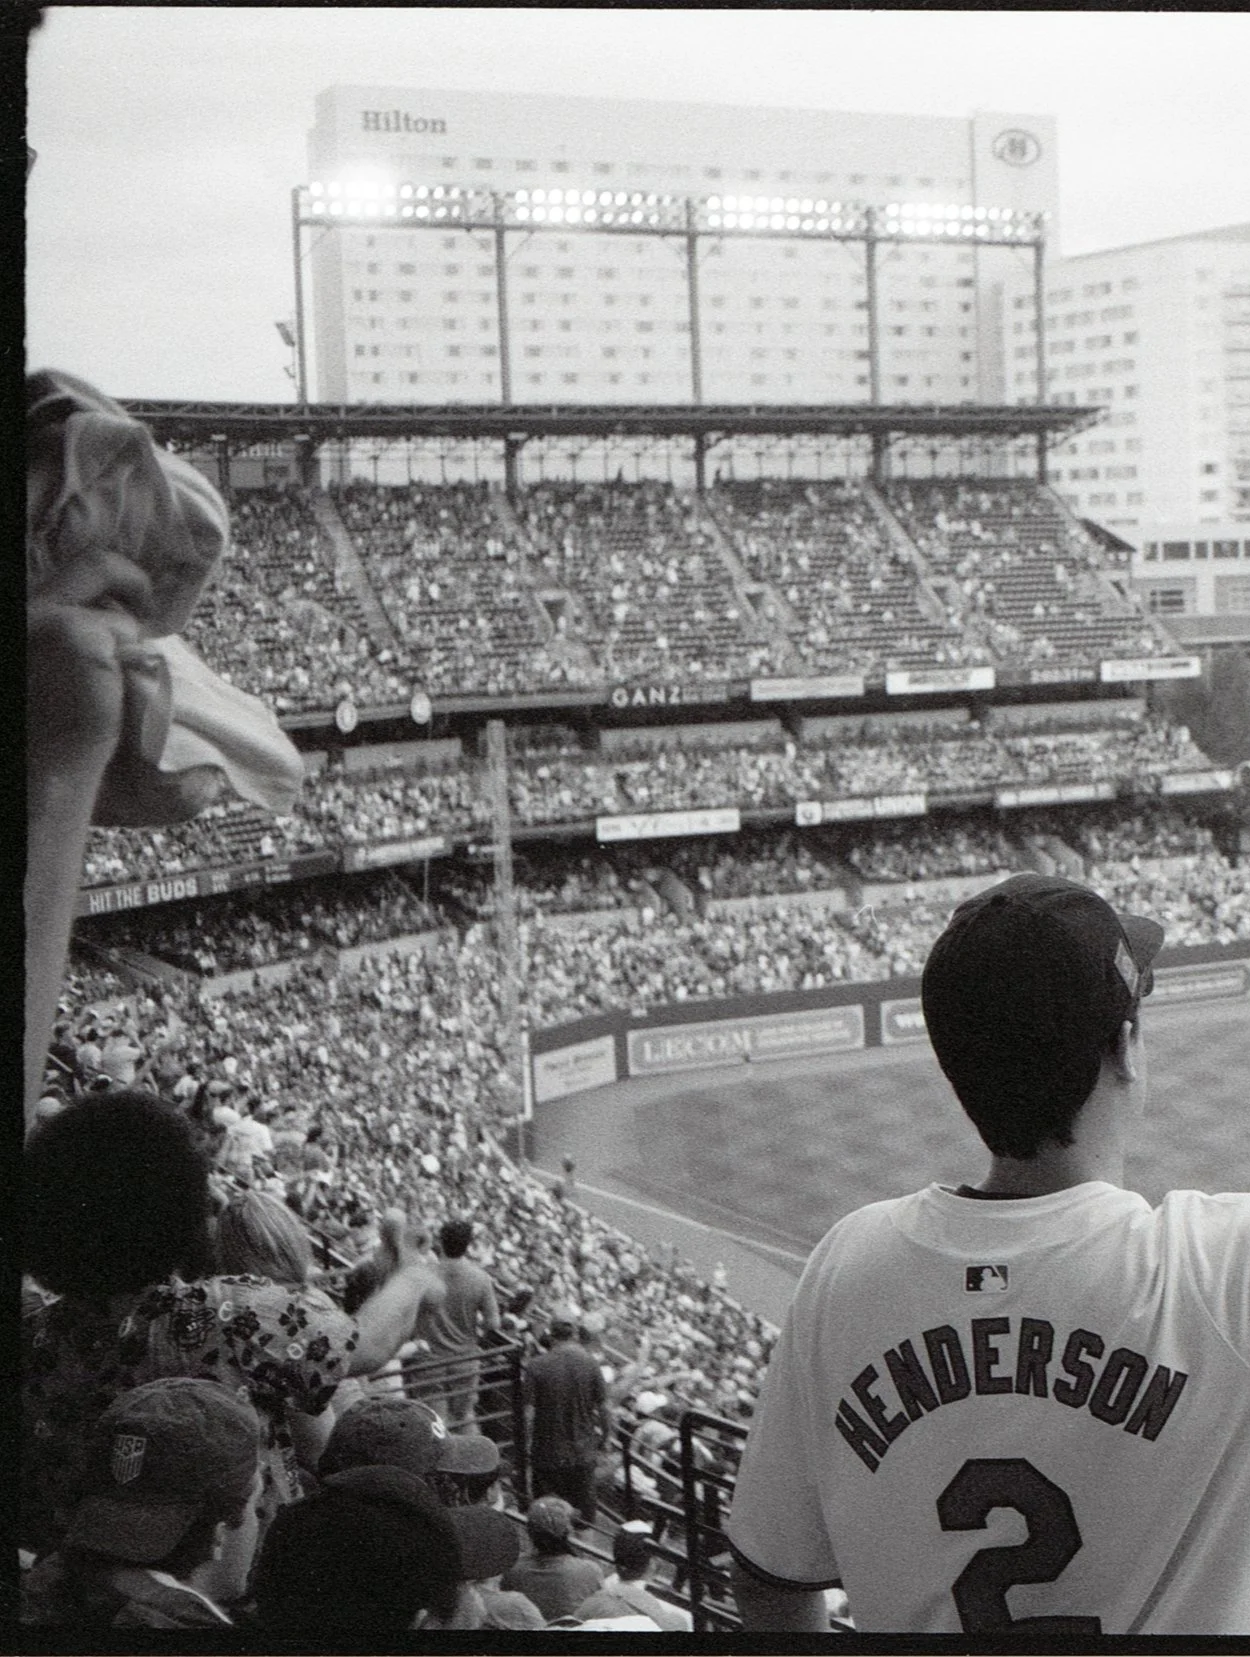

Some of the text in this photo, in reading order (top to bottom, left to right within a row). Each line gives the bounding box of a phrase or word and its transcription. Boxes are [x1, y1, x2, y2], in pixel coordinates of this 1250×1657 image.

[362, 109, 447, 133] Hilton
[89, 891, 112, 915] HIT
[116, 885, 142, 911] THE
[147, 877, 198, 905] BUDS
[835, 1317, 1188, 1474] HENDERSON
[936, 1458, 1102, 1634] 2
